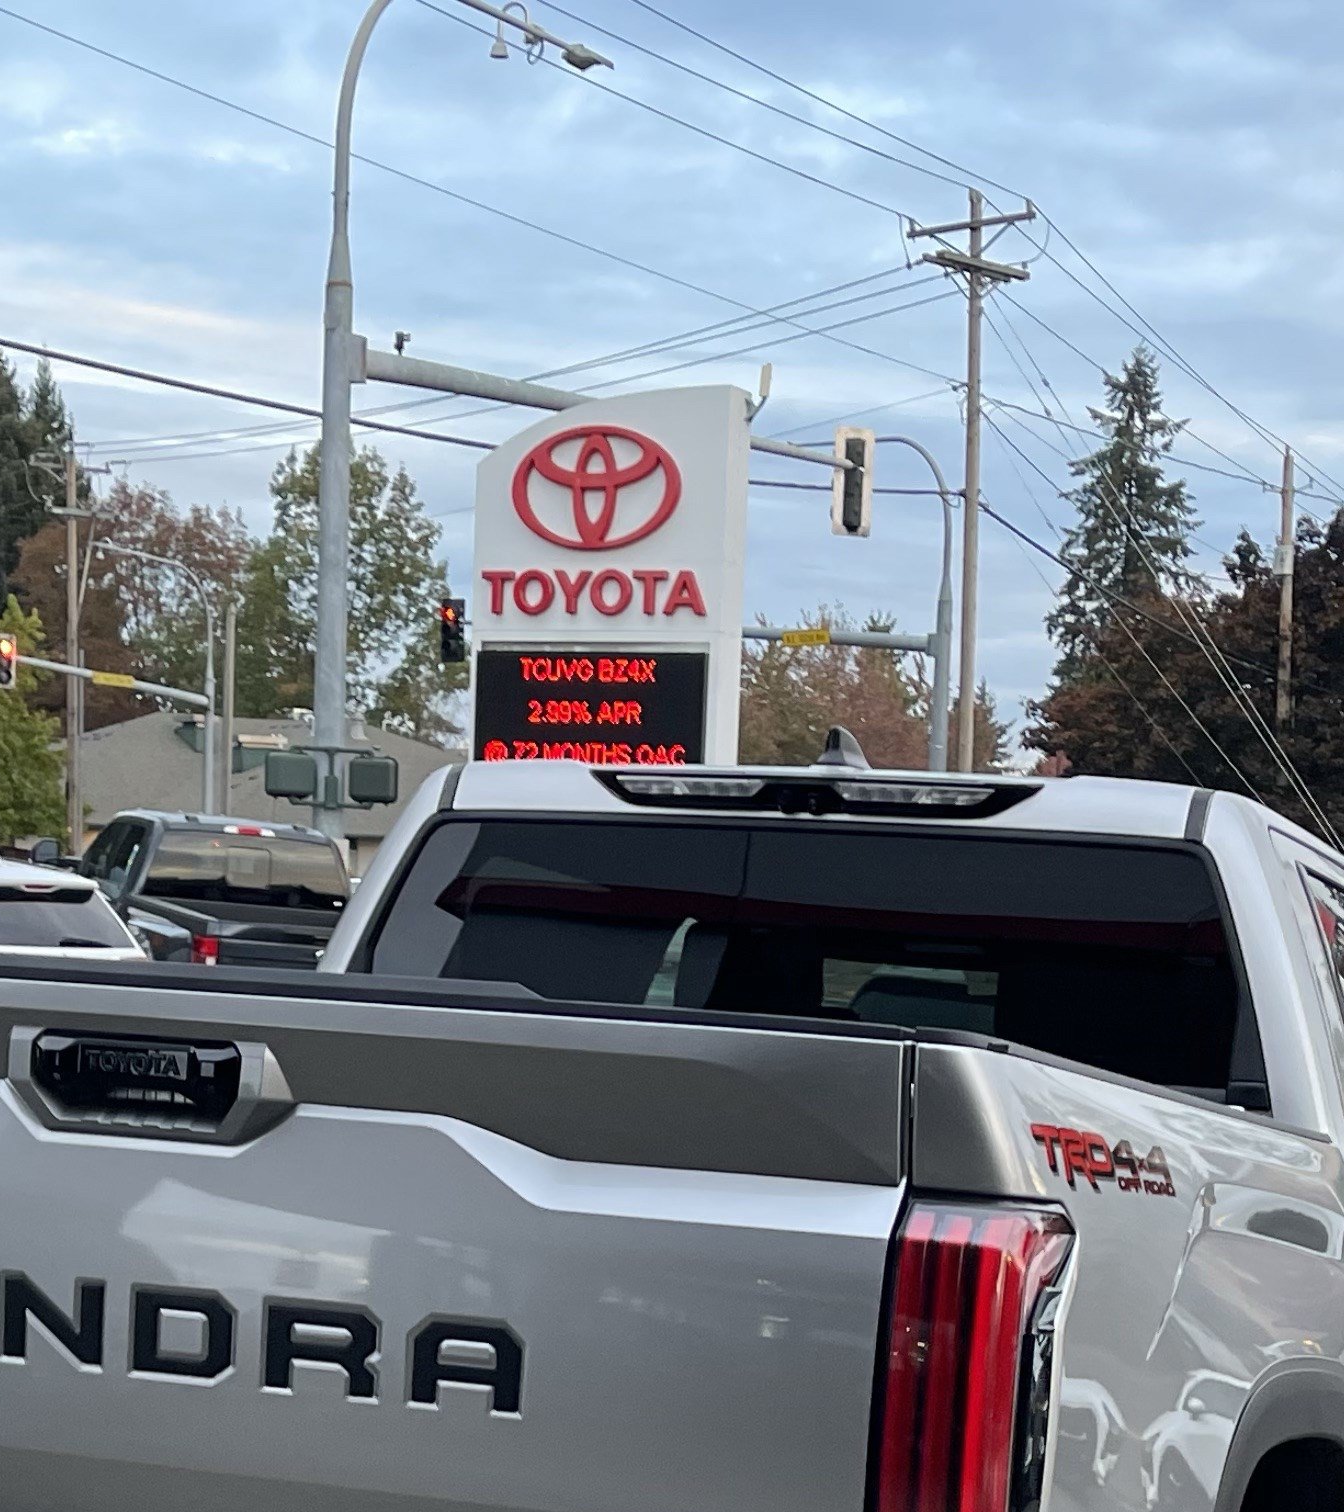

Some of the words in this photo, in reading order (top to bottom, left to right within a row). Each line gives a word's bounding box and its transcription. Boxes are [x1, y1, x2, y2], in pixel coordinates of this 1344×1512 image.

[481, 568, 707, 617] TOYOTA
[597, 658, 657, 684] BZ4X
[526, 699, 593, 726] 2.99%
[596, 700, 643, 726] APR
[512, 740, 539, 761] 72
[542, 741, 633, 767] MONTHS
[85, 1048, 183, 1078] TOYOTA
[1030, 1123, 1116, 1194] TRD
